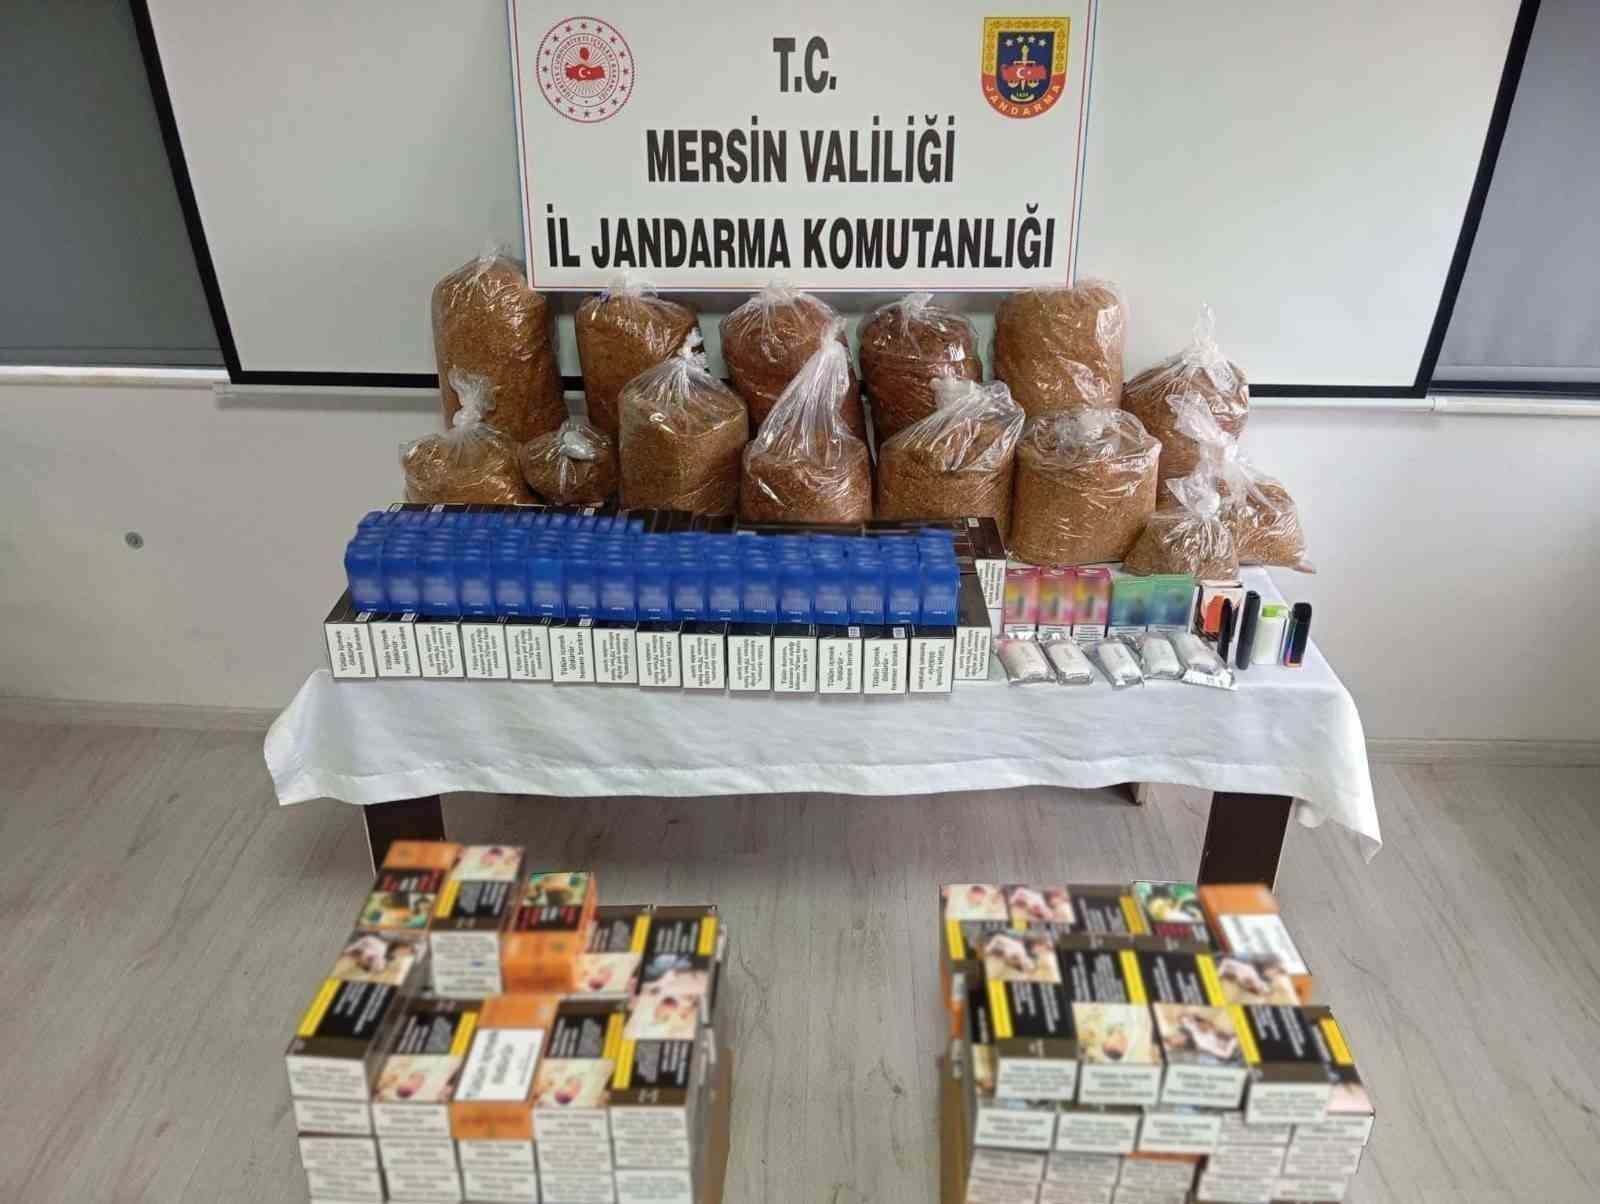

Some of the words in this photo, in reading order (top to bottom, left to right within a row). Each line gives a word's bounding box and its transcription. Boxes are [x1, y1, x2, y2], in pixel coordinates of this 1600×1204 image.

[773, 36, 837, 93] T.C.
[986, 84, 1061, 116] JANDARMA
[646, 115, 787, 184] MERSİN
[800, 113, 955, 184] VALİLİĞİ
[547, 204, 580, 268] İL
[592, 217, 791, 269] JANDARMA
[803, 203, 1056, 269] KOMUTANLIĞI
